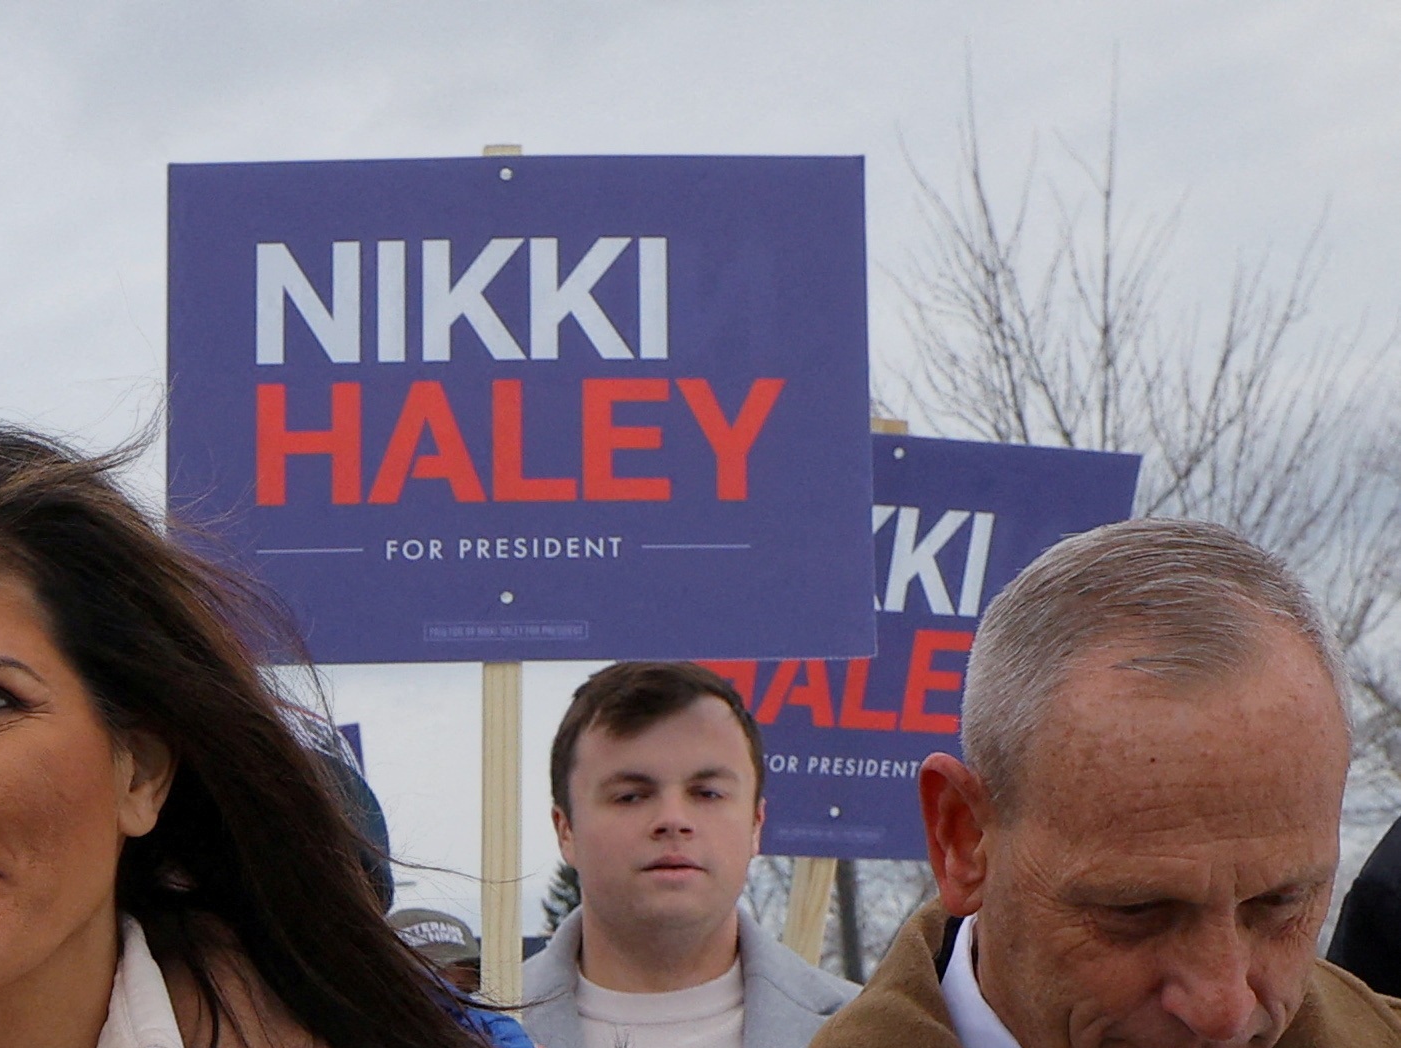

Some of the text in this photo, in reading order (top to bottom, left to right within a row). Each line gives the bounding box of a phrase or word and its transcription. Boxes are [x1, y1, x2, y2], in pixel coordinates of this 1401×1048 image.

[256, 236, 669, 365] NIKKI
[255, 377, 787, 506] HALEY
[385, 536, 624, 561] FOR PRESIDENT
[763, 754, 921, 778] OR PRESIDENT
